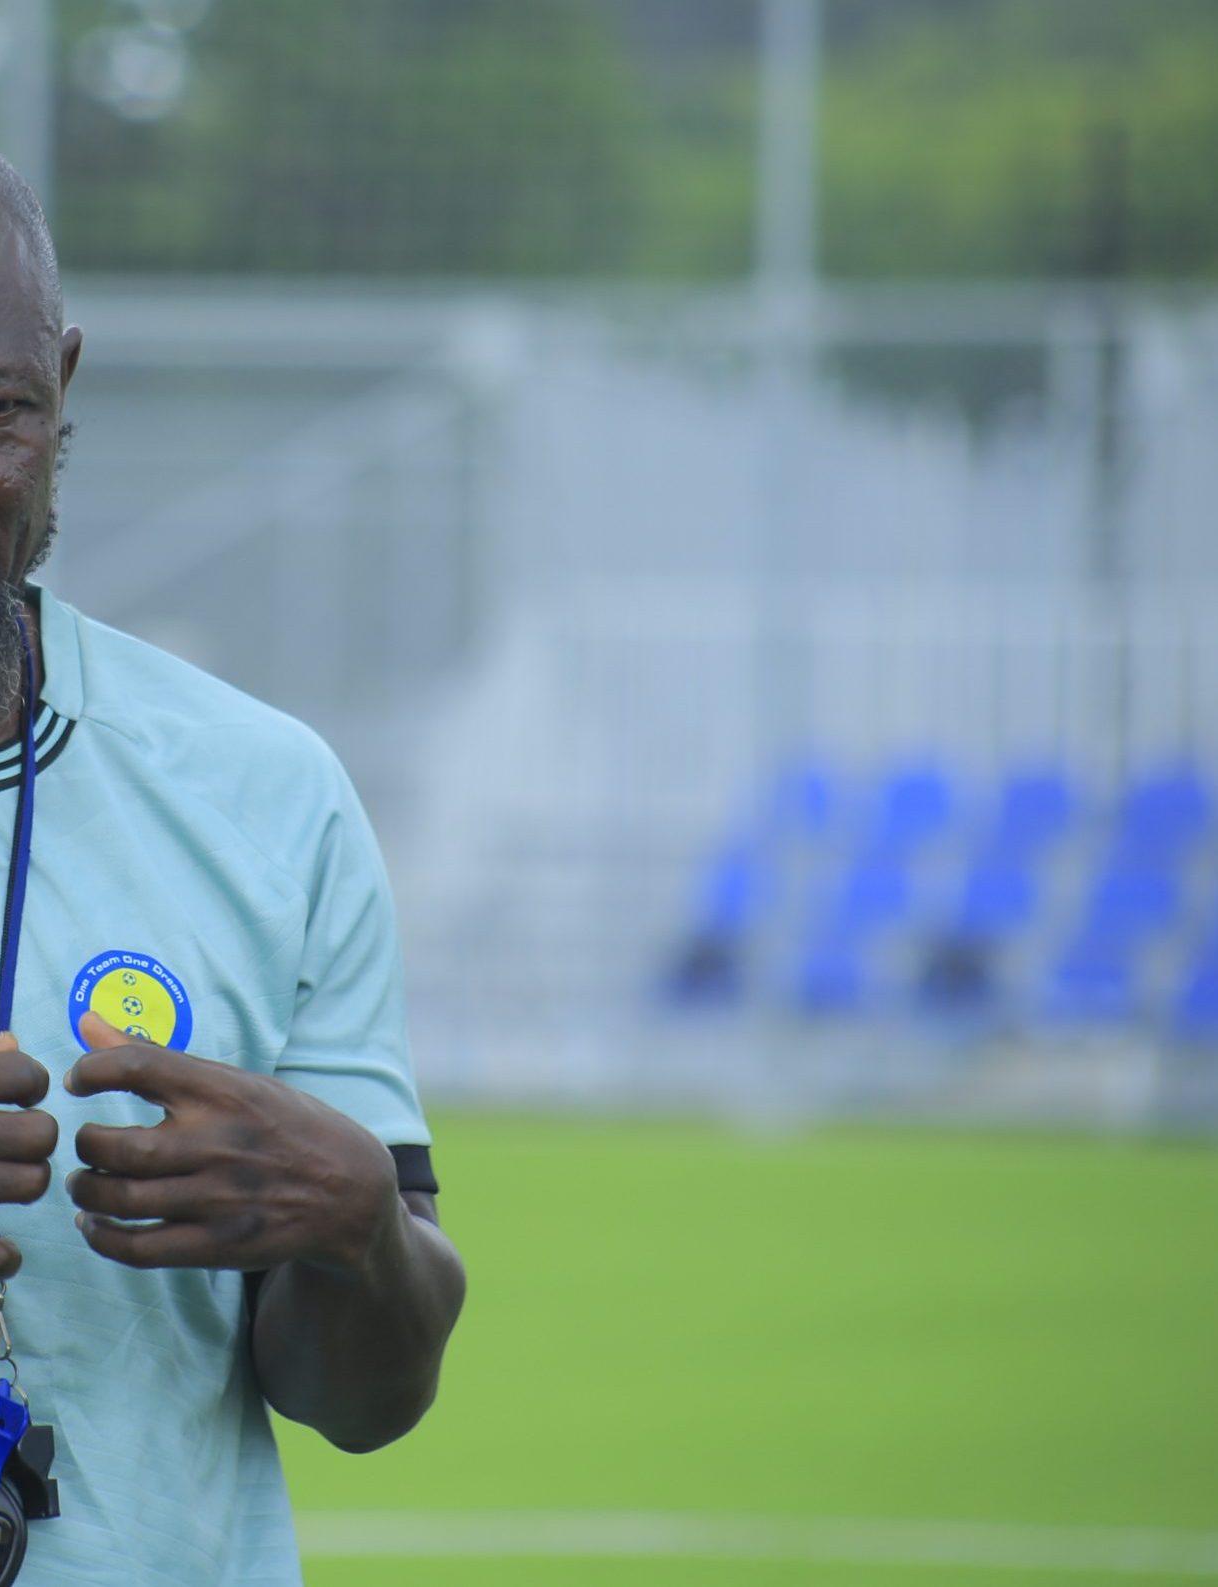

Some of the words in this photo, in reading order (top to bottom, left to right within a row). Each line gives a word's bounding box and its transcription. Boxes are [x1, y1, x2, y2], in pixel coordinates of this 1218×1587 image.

[75, 978, 90, 1003] One
[87, 956, 120, 976] Team
[122, 955, 149, 969] One
[152, 965, 184, 1003] Dream
